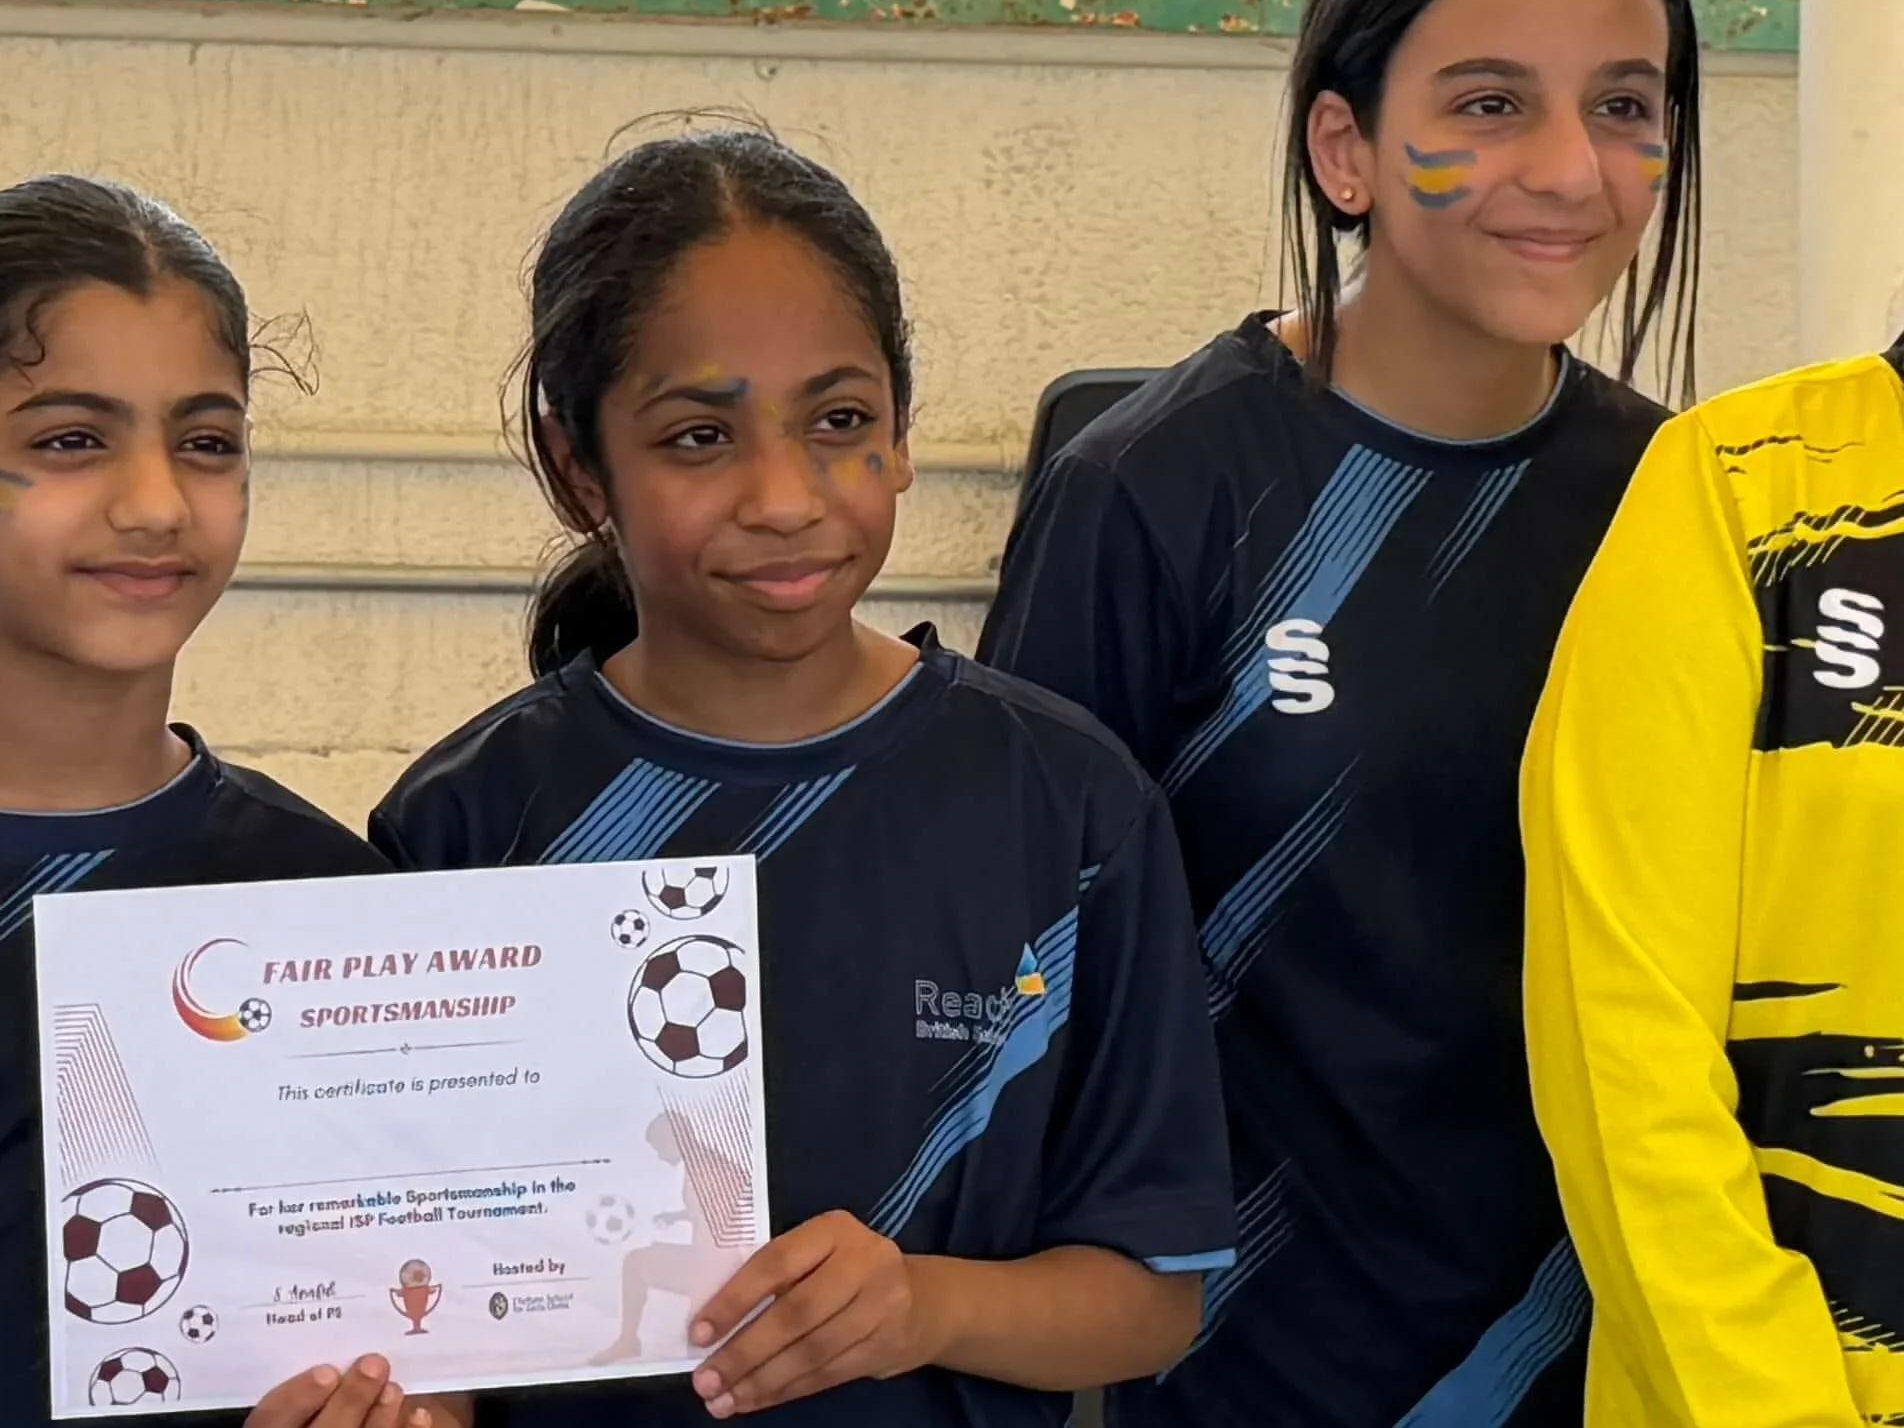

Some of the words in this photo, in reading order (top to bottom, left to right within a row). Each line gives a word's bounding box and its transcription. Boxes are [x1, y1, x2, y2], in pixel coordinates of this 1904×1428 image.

[263, 958, 332, 984] FAIR
[342, 952, 419, 979] PLAY
[426, 944, 542, 973] AWARD
[300, 995, 516, 1028] SPORTSMANSHIP
[277, 1085, 309, 1101] This
[411, 1077, 425, 1092] is
[427, 1066, 519, 1096] presented
[524, 1069, 541, 1084] to
[309, 1191, 402, 1212] remarkable
[406, 1180, 528, 1207] Sportsmanship
[550, 1175, 577, 1194] the
[378, 1206, 443, 1226] Football
[492, 1258, 545, 1276] Hosted
[548, 1257, 566, 1276] by
